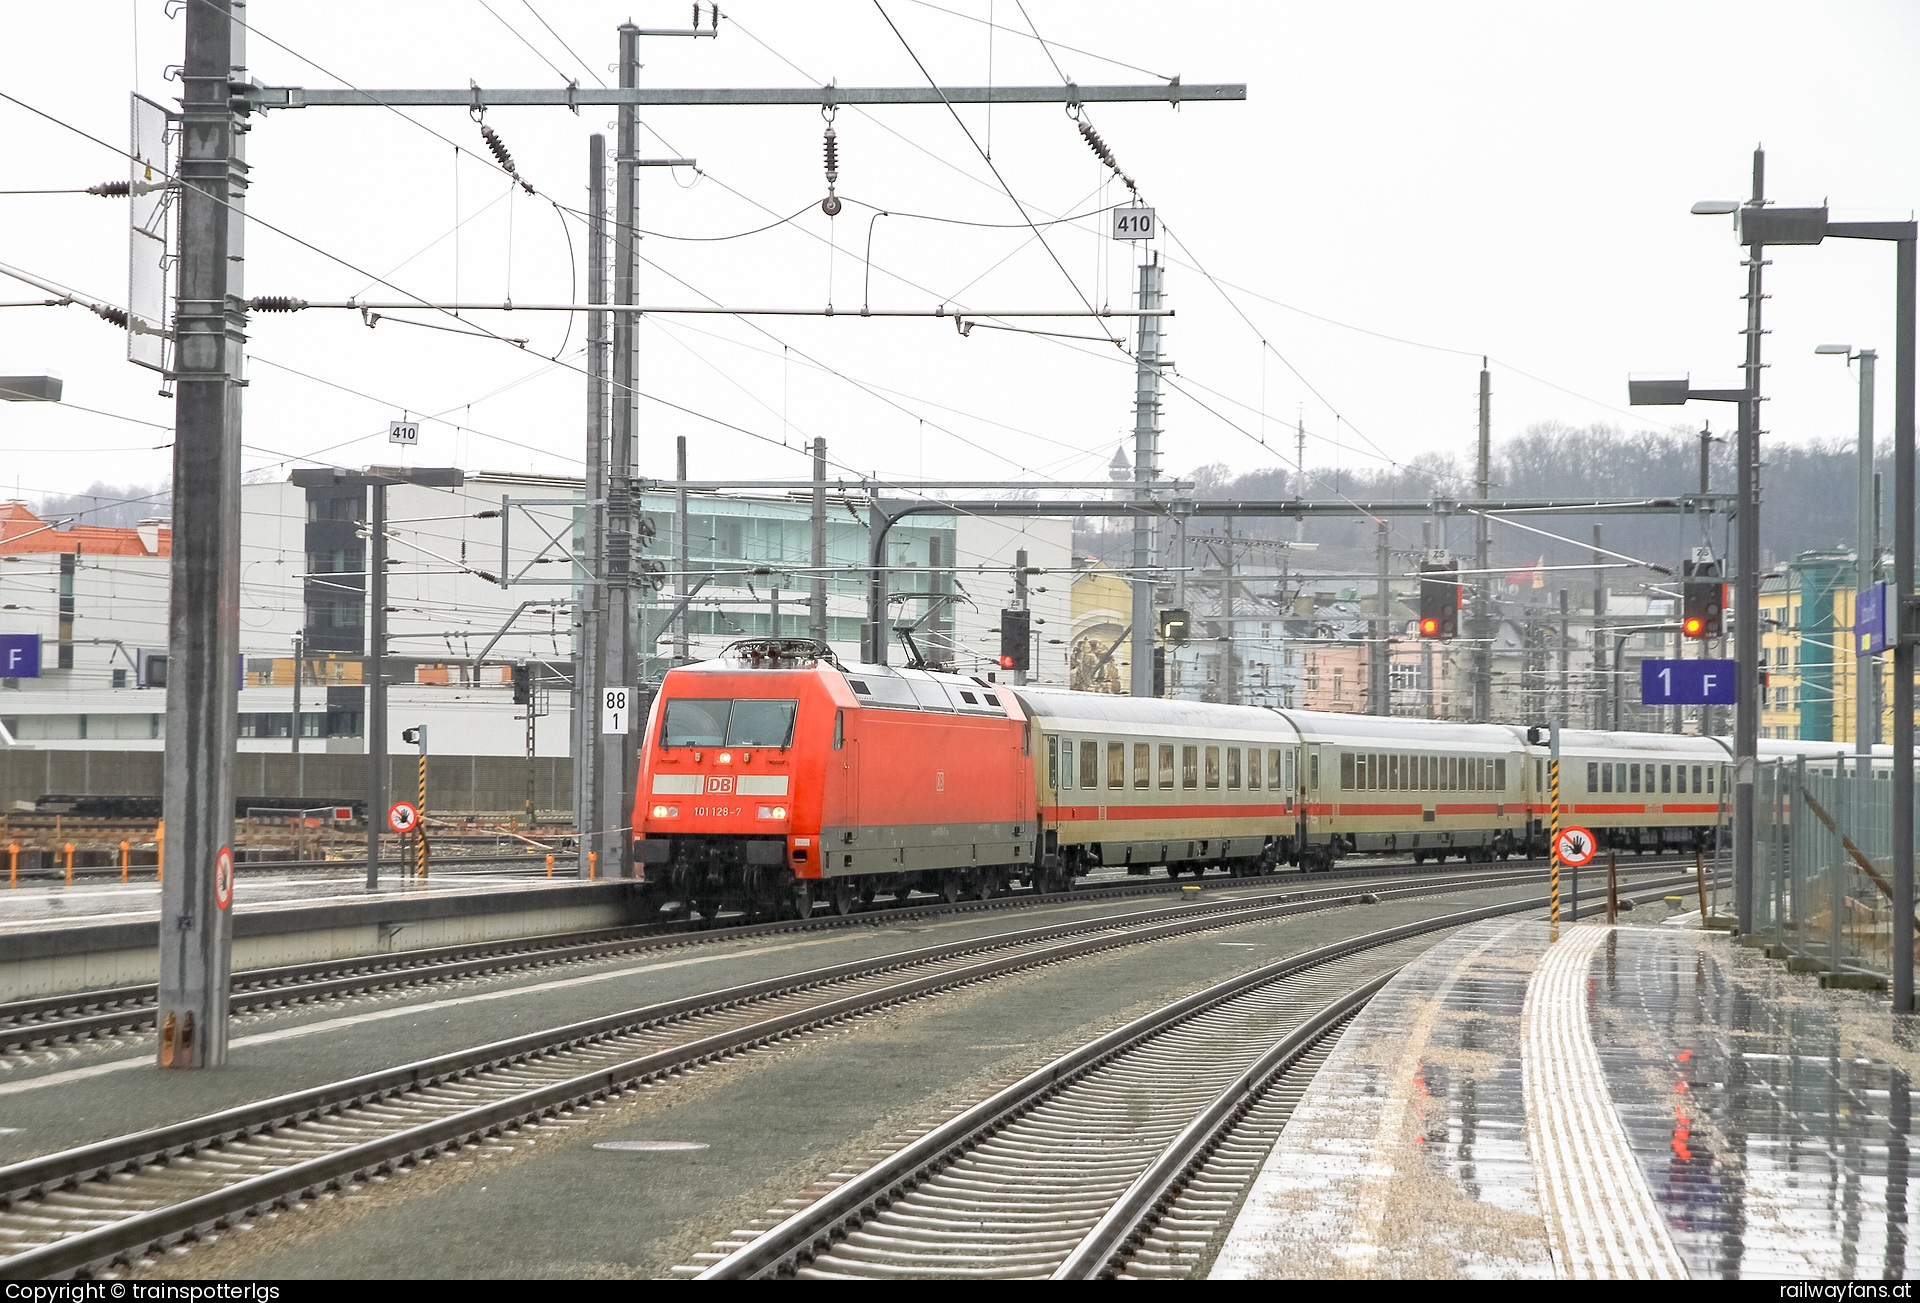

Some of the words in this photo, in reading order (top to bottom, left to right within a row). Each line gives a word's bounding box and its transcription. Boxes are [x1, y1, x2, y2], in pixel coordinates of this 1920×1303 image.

[1118, 216, 1150, 231] 410
[393, 427, 415, 439] 410
[9, 649, 22, 669] F
[1658, 668, 1671, 696] 1
[1703, 675, 1717, 696] F
[606, 692, 625, 709] 88
[612, 713, 618, 729] 1
[709, 778, 732, 792] DB
[694, 807, 709, 816] 101
